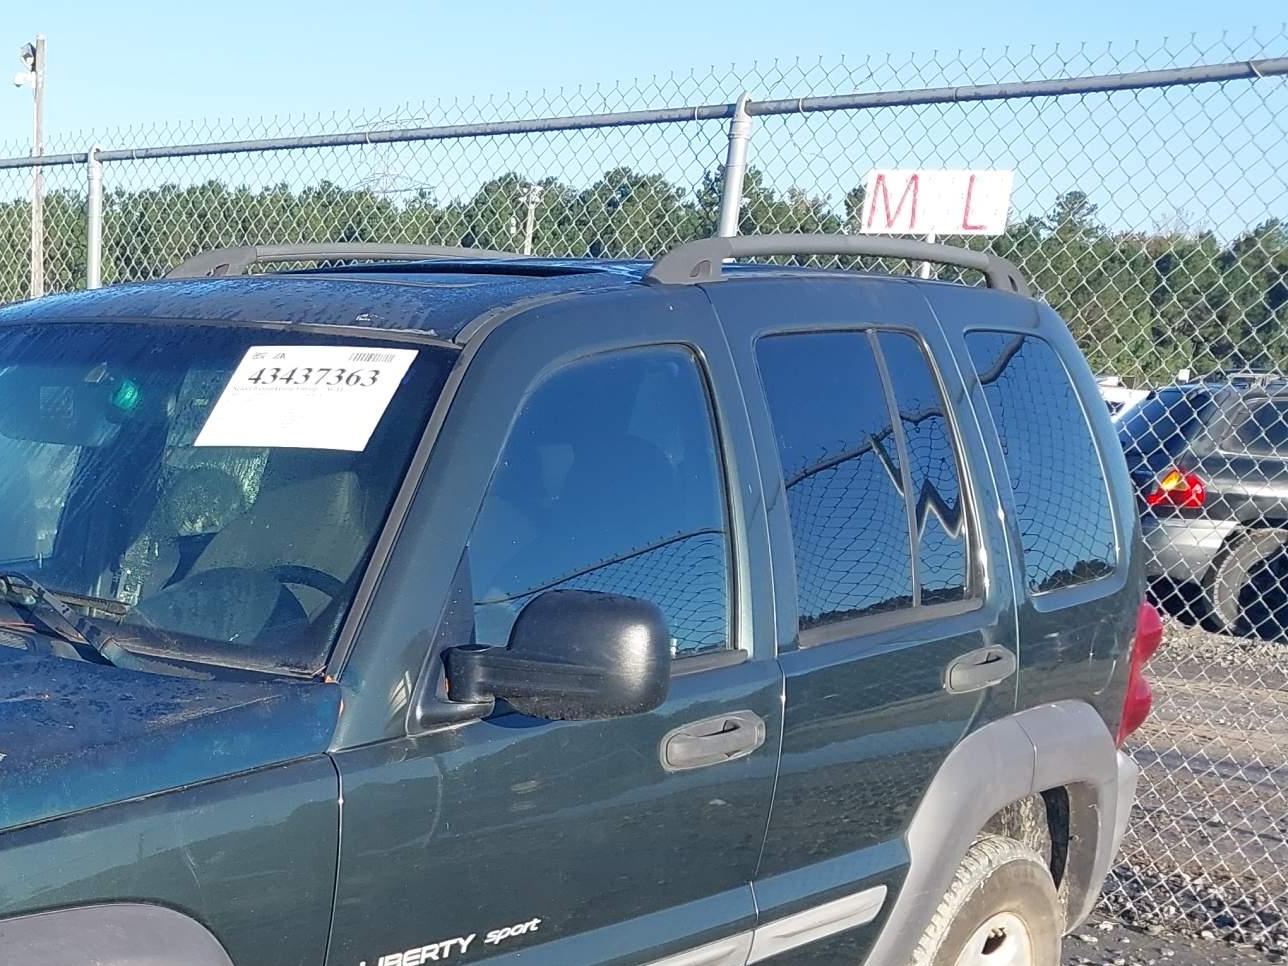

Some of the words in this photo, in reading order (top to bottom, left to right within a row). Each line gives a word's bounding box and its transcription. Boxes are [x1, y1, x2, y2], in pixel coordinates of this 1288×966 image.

[866, 173, 920, 229] M
[962, 173, 987, 231] L
[247, 366, 381, 388] 43437363
[483, 916, 542, 945] sport
